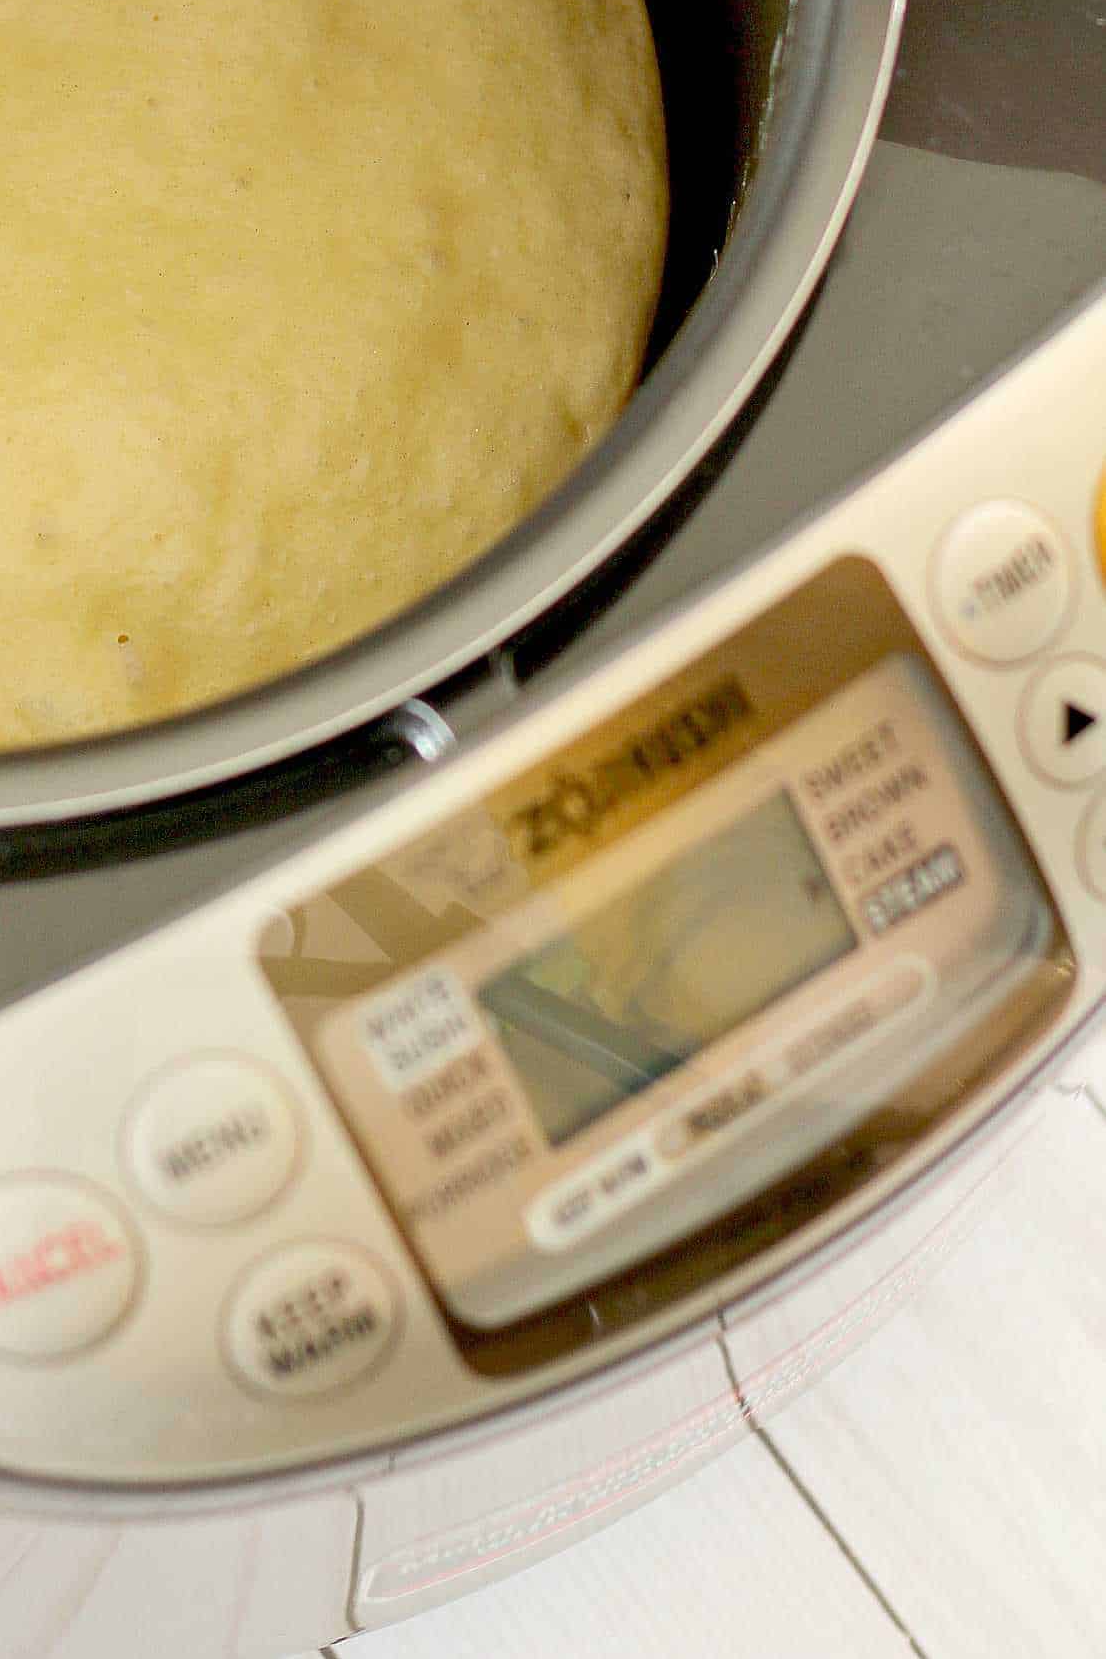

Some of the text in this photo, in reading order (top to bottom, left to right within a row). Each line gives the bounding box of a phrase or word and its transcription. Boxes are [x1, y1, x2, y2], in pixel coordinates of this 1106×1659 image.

[824, 759, 930, 843] BROWN
[862, 847, 962, 933] STEAM
[159, 1109, 271, 1181] MENU
[260, 1270, 350, 1339] KEEP
[269, 1300, 377, 1377] WARM
